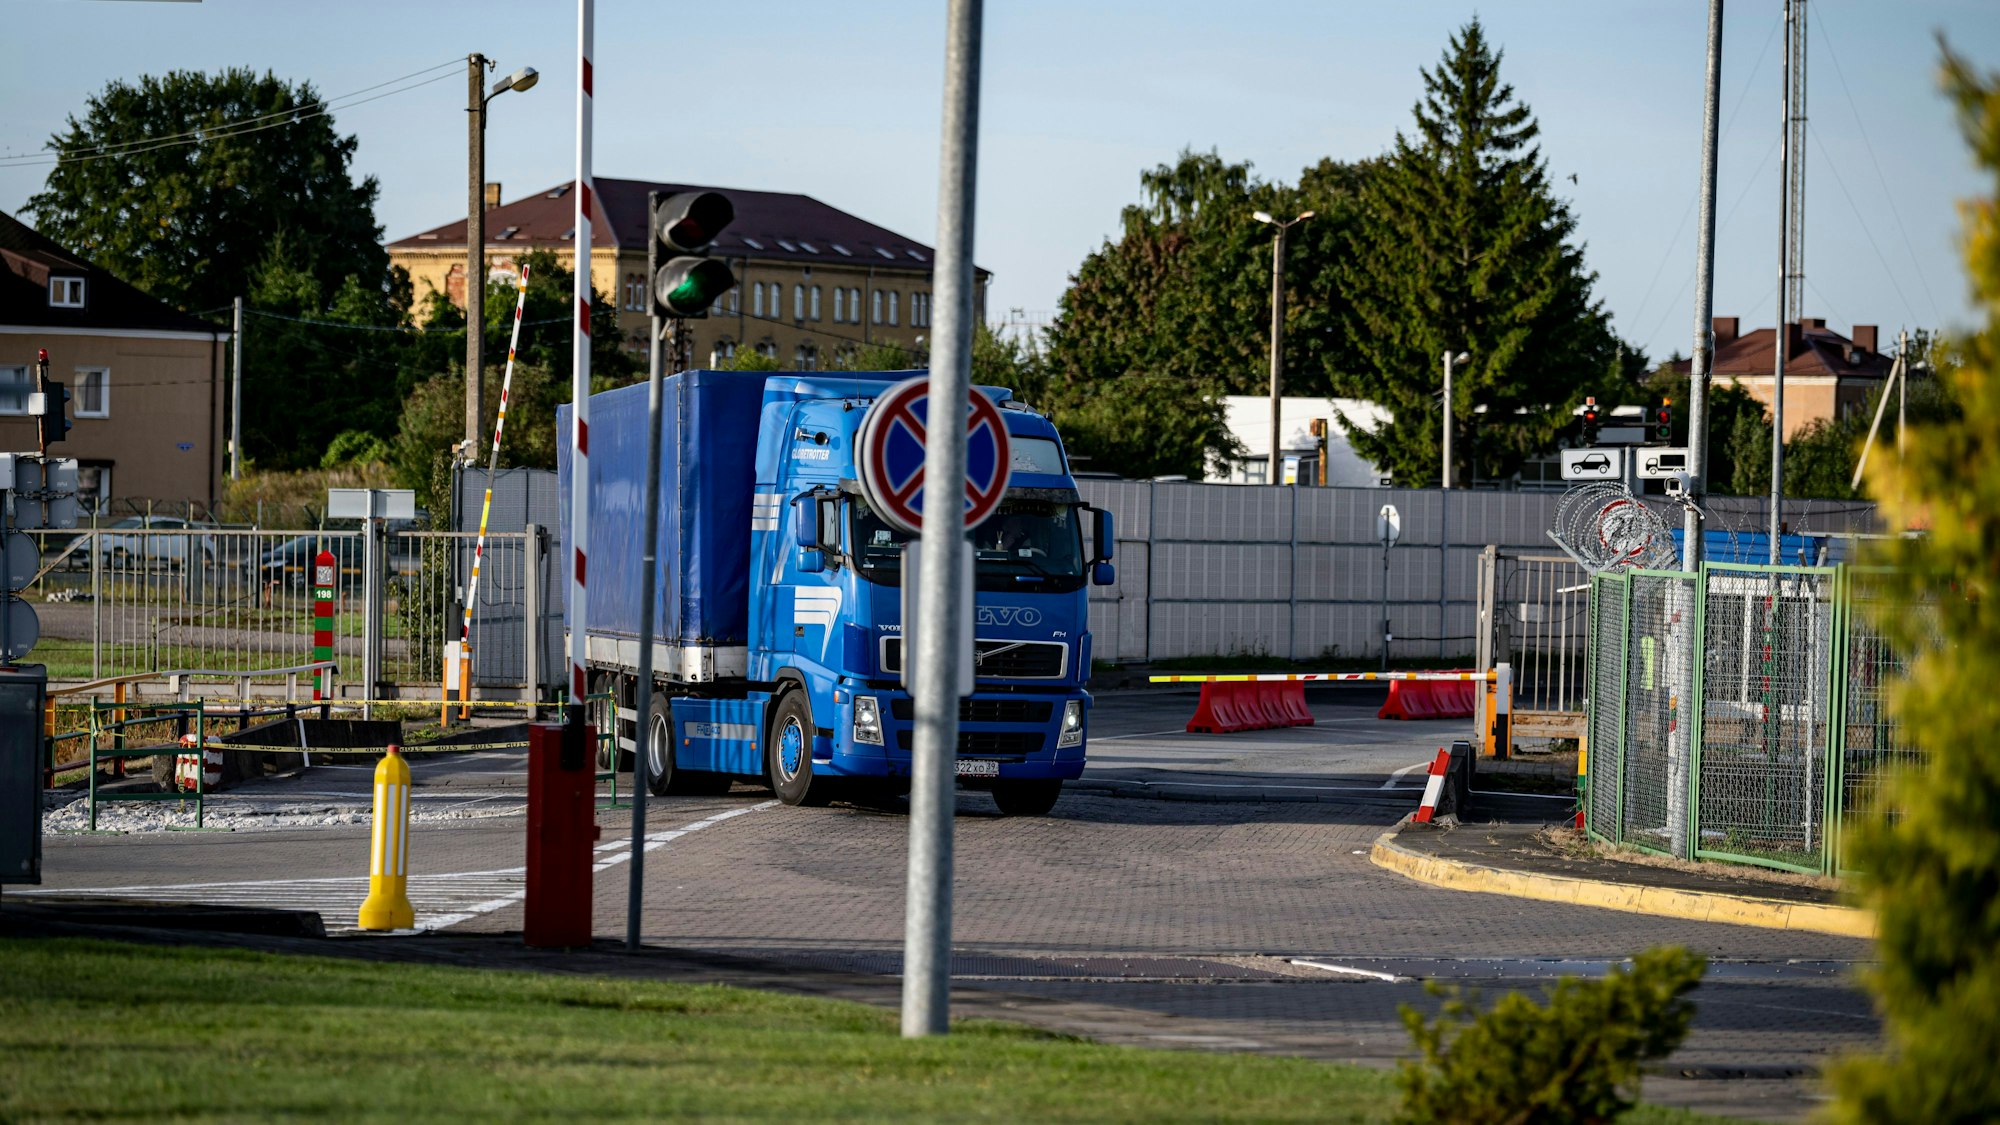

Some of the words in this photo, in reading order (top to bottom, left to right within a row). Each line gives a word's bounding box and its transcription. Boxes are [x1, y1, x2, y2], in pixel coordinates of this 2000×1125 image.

[791, 448, 830, 461] GLOBETROTTER
[316, 590, 332, 599] 198
[976, 605, 1042, 627] LVO
